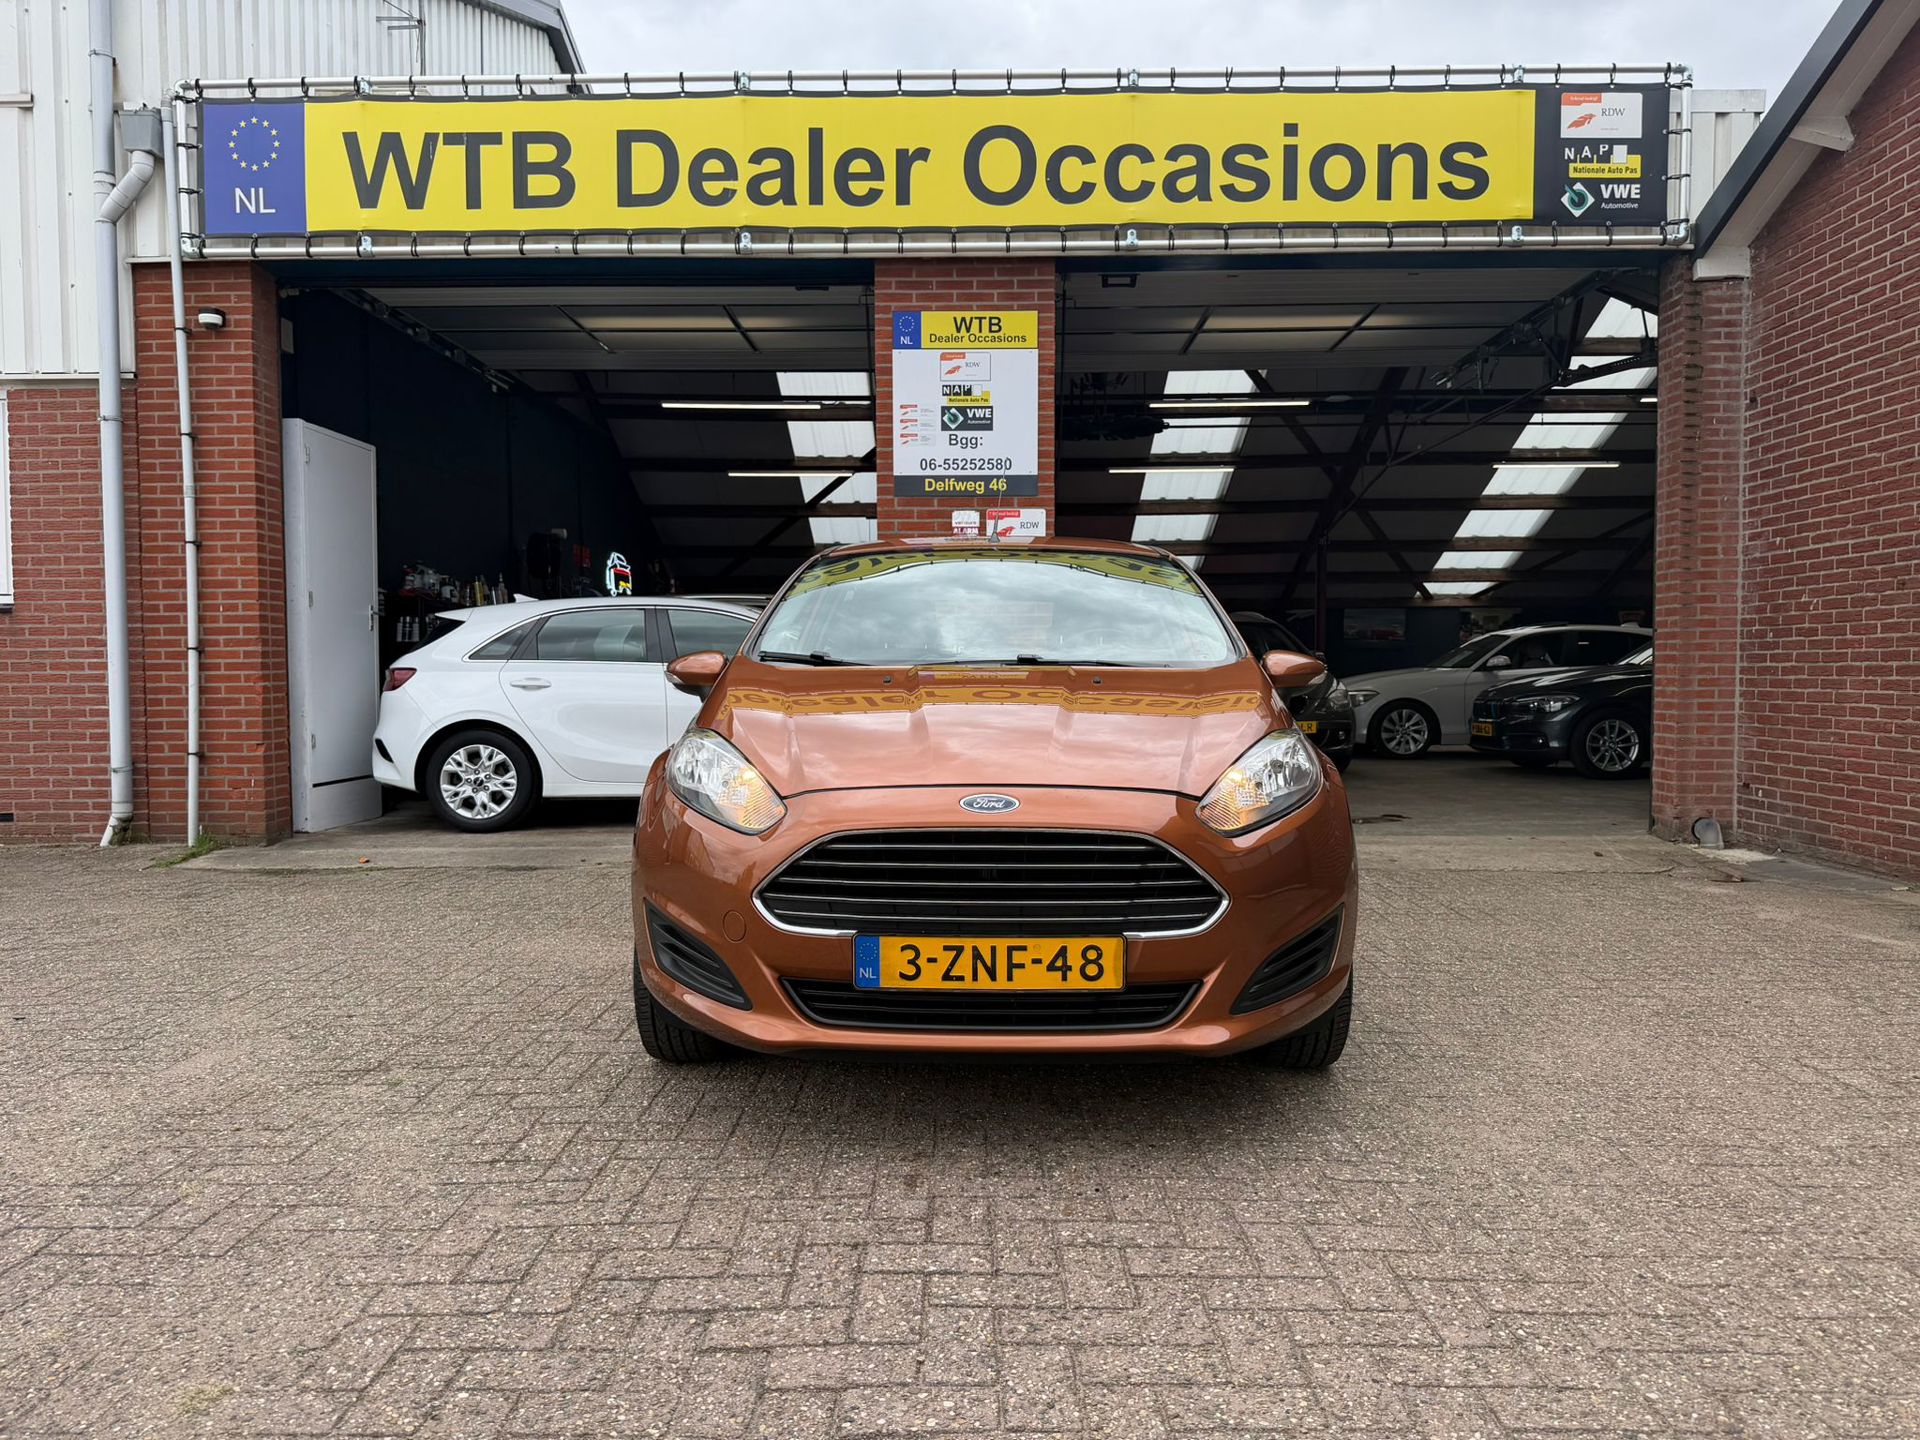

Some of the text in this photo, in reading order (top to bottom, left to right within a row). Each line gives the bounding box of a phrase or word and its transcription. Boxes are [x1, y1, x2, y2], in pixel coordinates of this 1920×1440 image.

[1601, 108, 1625, 117] RDW
[341, 122, 1491, 211] WTB Dealer Occasions
[1572, 166, 1638, 174] Nationale Auto Pas
[1600, 184, 1641, 199] VWE
[234, 187, 277, 214] NL
[953, 316, 1003, 334] WTB
[900, 335, 913, 345] NL
[929, 333, 1027, 344] Dealer Occasions
[966, 408, 992, 418] VWE
[948, 434, 983, 449] Bgg:
[919, 458, 1012, 471] 06-55252580
[924, 478, 1007, 493] Delfweg 46
[1020, 521, 1040, 529] RDW
[973, 797, 1006, 808] Ford
[898, 944, 1105, 982] 3-ZNF-48
[859, 967, 877, 979] NL
